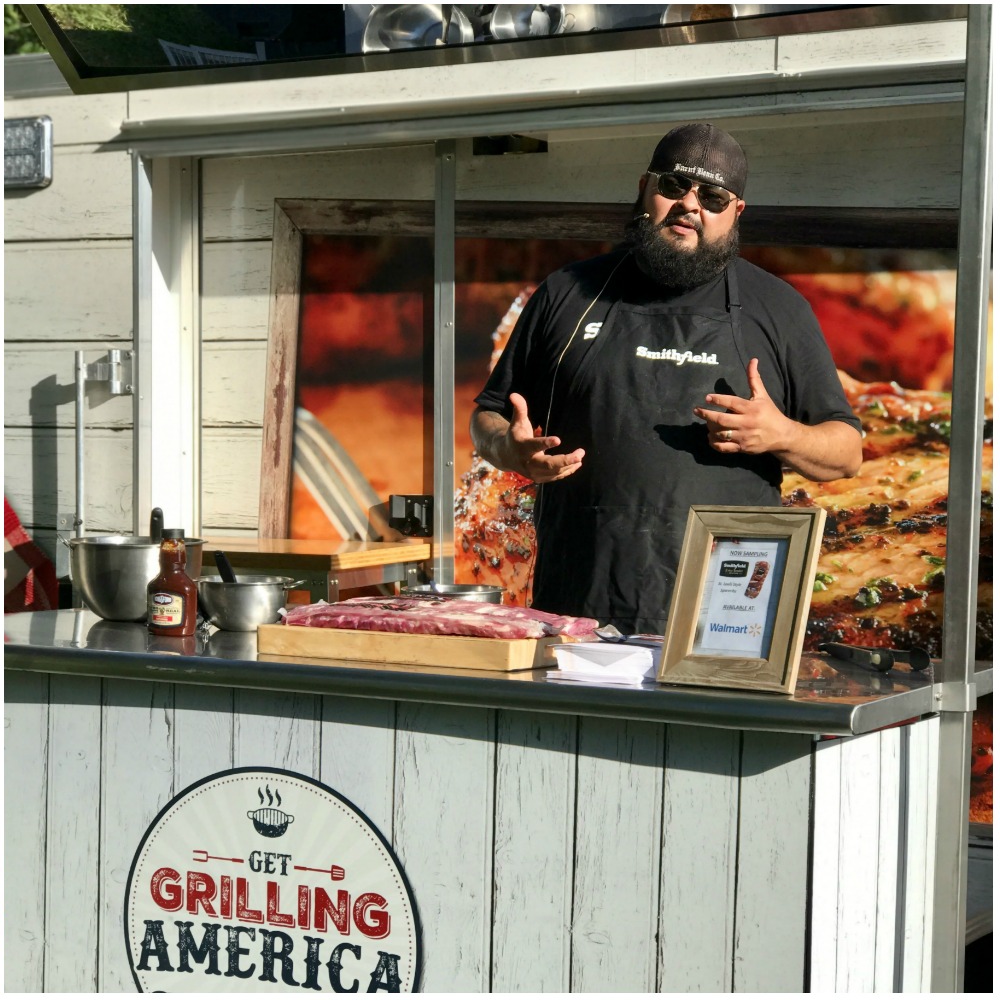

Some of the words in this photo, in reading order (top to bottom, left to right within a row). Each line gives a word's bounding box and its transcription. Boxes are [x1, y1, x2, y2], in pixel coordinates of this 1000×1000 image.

[636, 346, 719, 366] Smithfield
[710, 623, 748, 634] Walmart
[249, 851, 292, 876] GET
[150, 867, 391, 940] GRILLING
[136, 920, 402, 993] AMERICA
